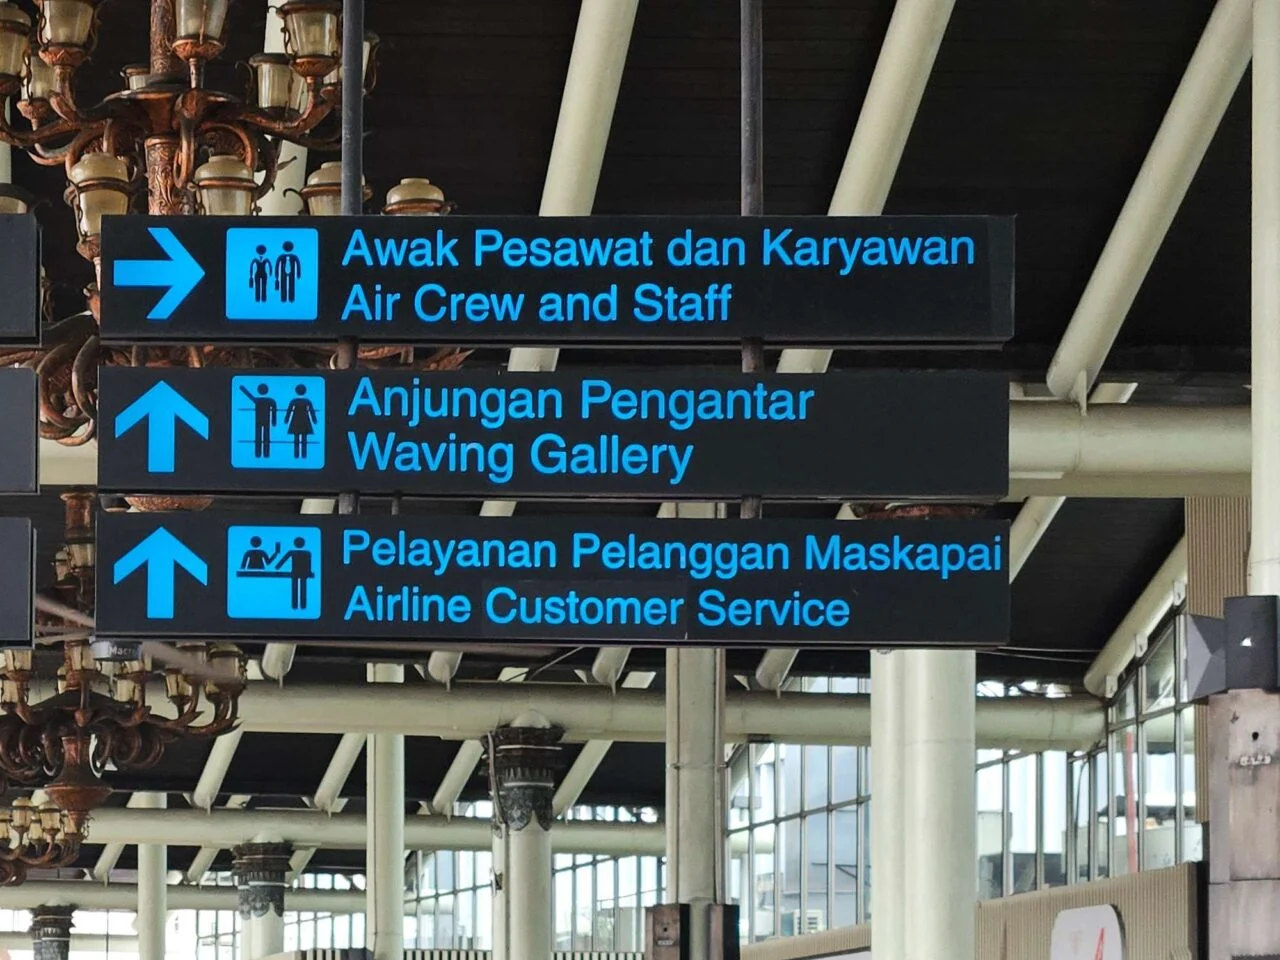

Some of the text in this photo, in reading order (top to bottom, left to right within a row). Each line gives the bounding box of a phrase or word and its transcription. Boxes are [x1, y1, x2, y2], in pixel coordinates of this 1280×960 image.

[341, 228, 975, 276] Awak Pesawat dan Karyawan
[340, 282, 733, 323] Air Crew and Staff
[347, 376, 815, 431] Anjungan Pengantar
[347, 431, 694, 485] Waving Gallery
[342, 529, 1001, 580] Pelayanan Pelanggan Maskapai
[343, 584, 850, 627] Airline Customer Service
